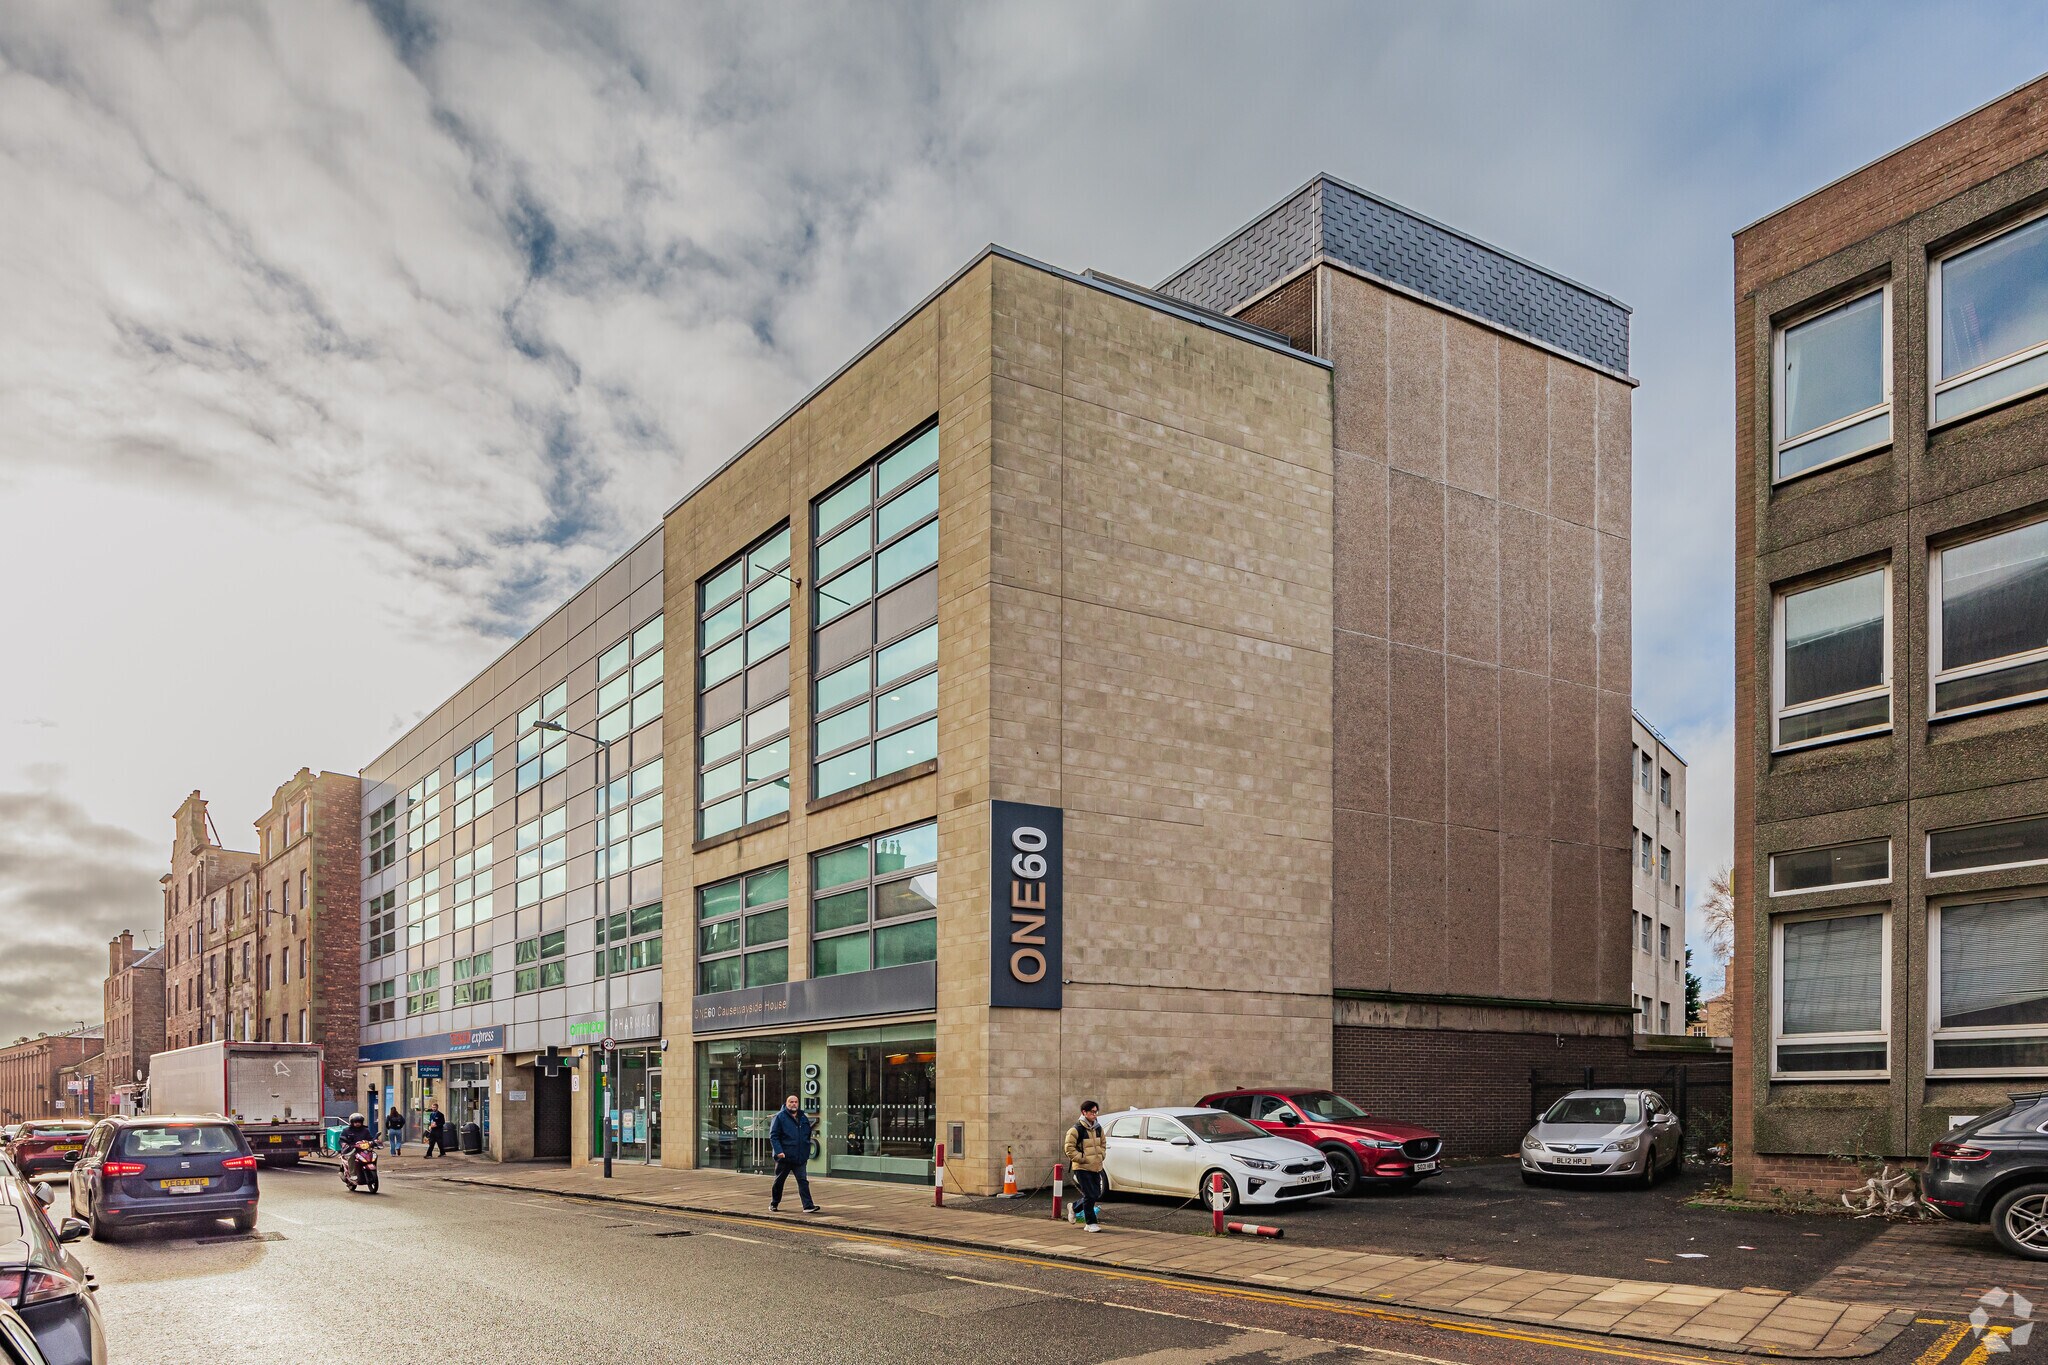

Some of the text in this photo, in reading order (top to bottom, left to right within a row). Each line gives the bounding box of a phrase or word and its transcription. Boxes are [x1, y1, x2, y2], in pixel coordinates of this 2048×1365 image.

[1010, 826, 1048, 983] ONE60
[694, 1000, 787, 1019] ONE60 Causewayside House
[614, 1013, 656, 1031] PHARMACY
[472, 1031, 494, 1047] express
[1557, 1157, 1571, 1165] BL12
[164, 1179, 188, 1187] YE67
